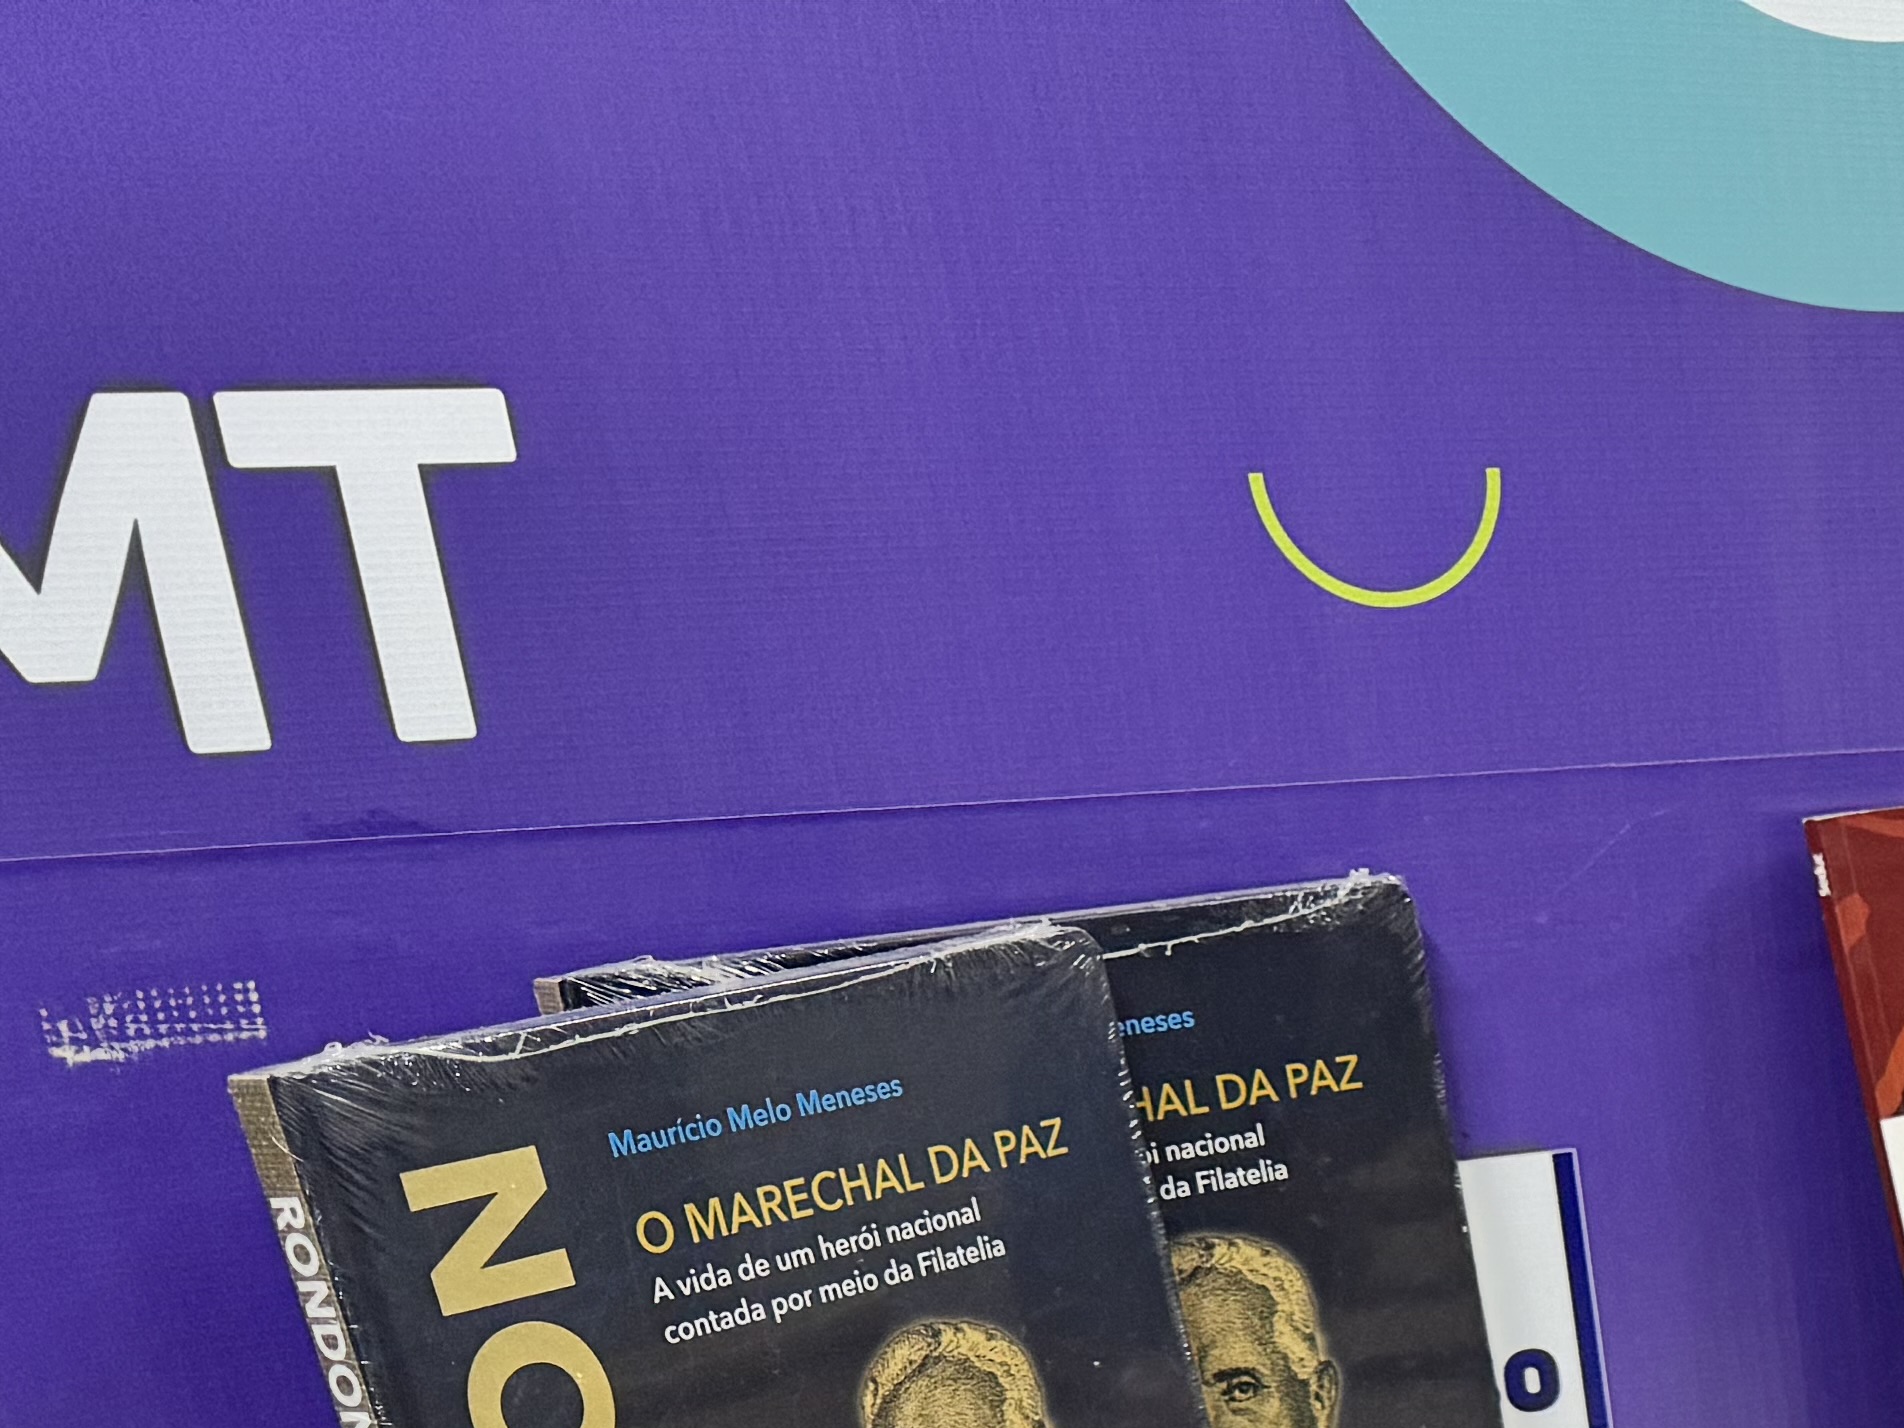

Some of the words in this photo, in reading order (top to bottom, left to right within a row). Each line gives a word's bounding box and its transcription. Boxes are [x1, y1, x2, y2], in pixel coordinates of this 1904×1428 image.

[0, 388, 517, 754] MT
[607, 1113, 722, 1158] Maurício
[726, 1098, 791, 1134] Melo
[796, 1078, 903, 1117] Meneses
[1216, 1068, 1280, 1111] DA
[1285, 1055, 1363, 1099] PAZ
[635, 1211, 674, 1254] O
[683, 1153, 924, 1245] MARECHAL
[927, 1138, 991, 1185] DA
[993, 1117, 1069, 1169] PAZ
[1159, 1174, 1191, 1201] da
[1195, 1160, 1289, 1195] Filatelia
[1165, 1123, 1266, 1164] nacional
[652, 1277, 674, 1304] A
[676, 1262, 733, 1300] vida
[737, 1252, 771, 1283] de
[776, 1244, 816, 1273] um
[818, 1225, 882, 1263] herói
[885, 1197, 981, 1244] nacional
[664, 1298, 766, 1345] contada
[771, 1290, 813, 1324] por
[819, 1269, 879, 1310] meio
[883, 1258, 914, 1287] da
[917, 1235, 1007, 1278] Filatelia
